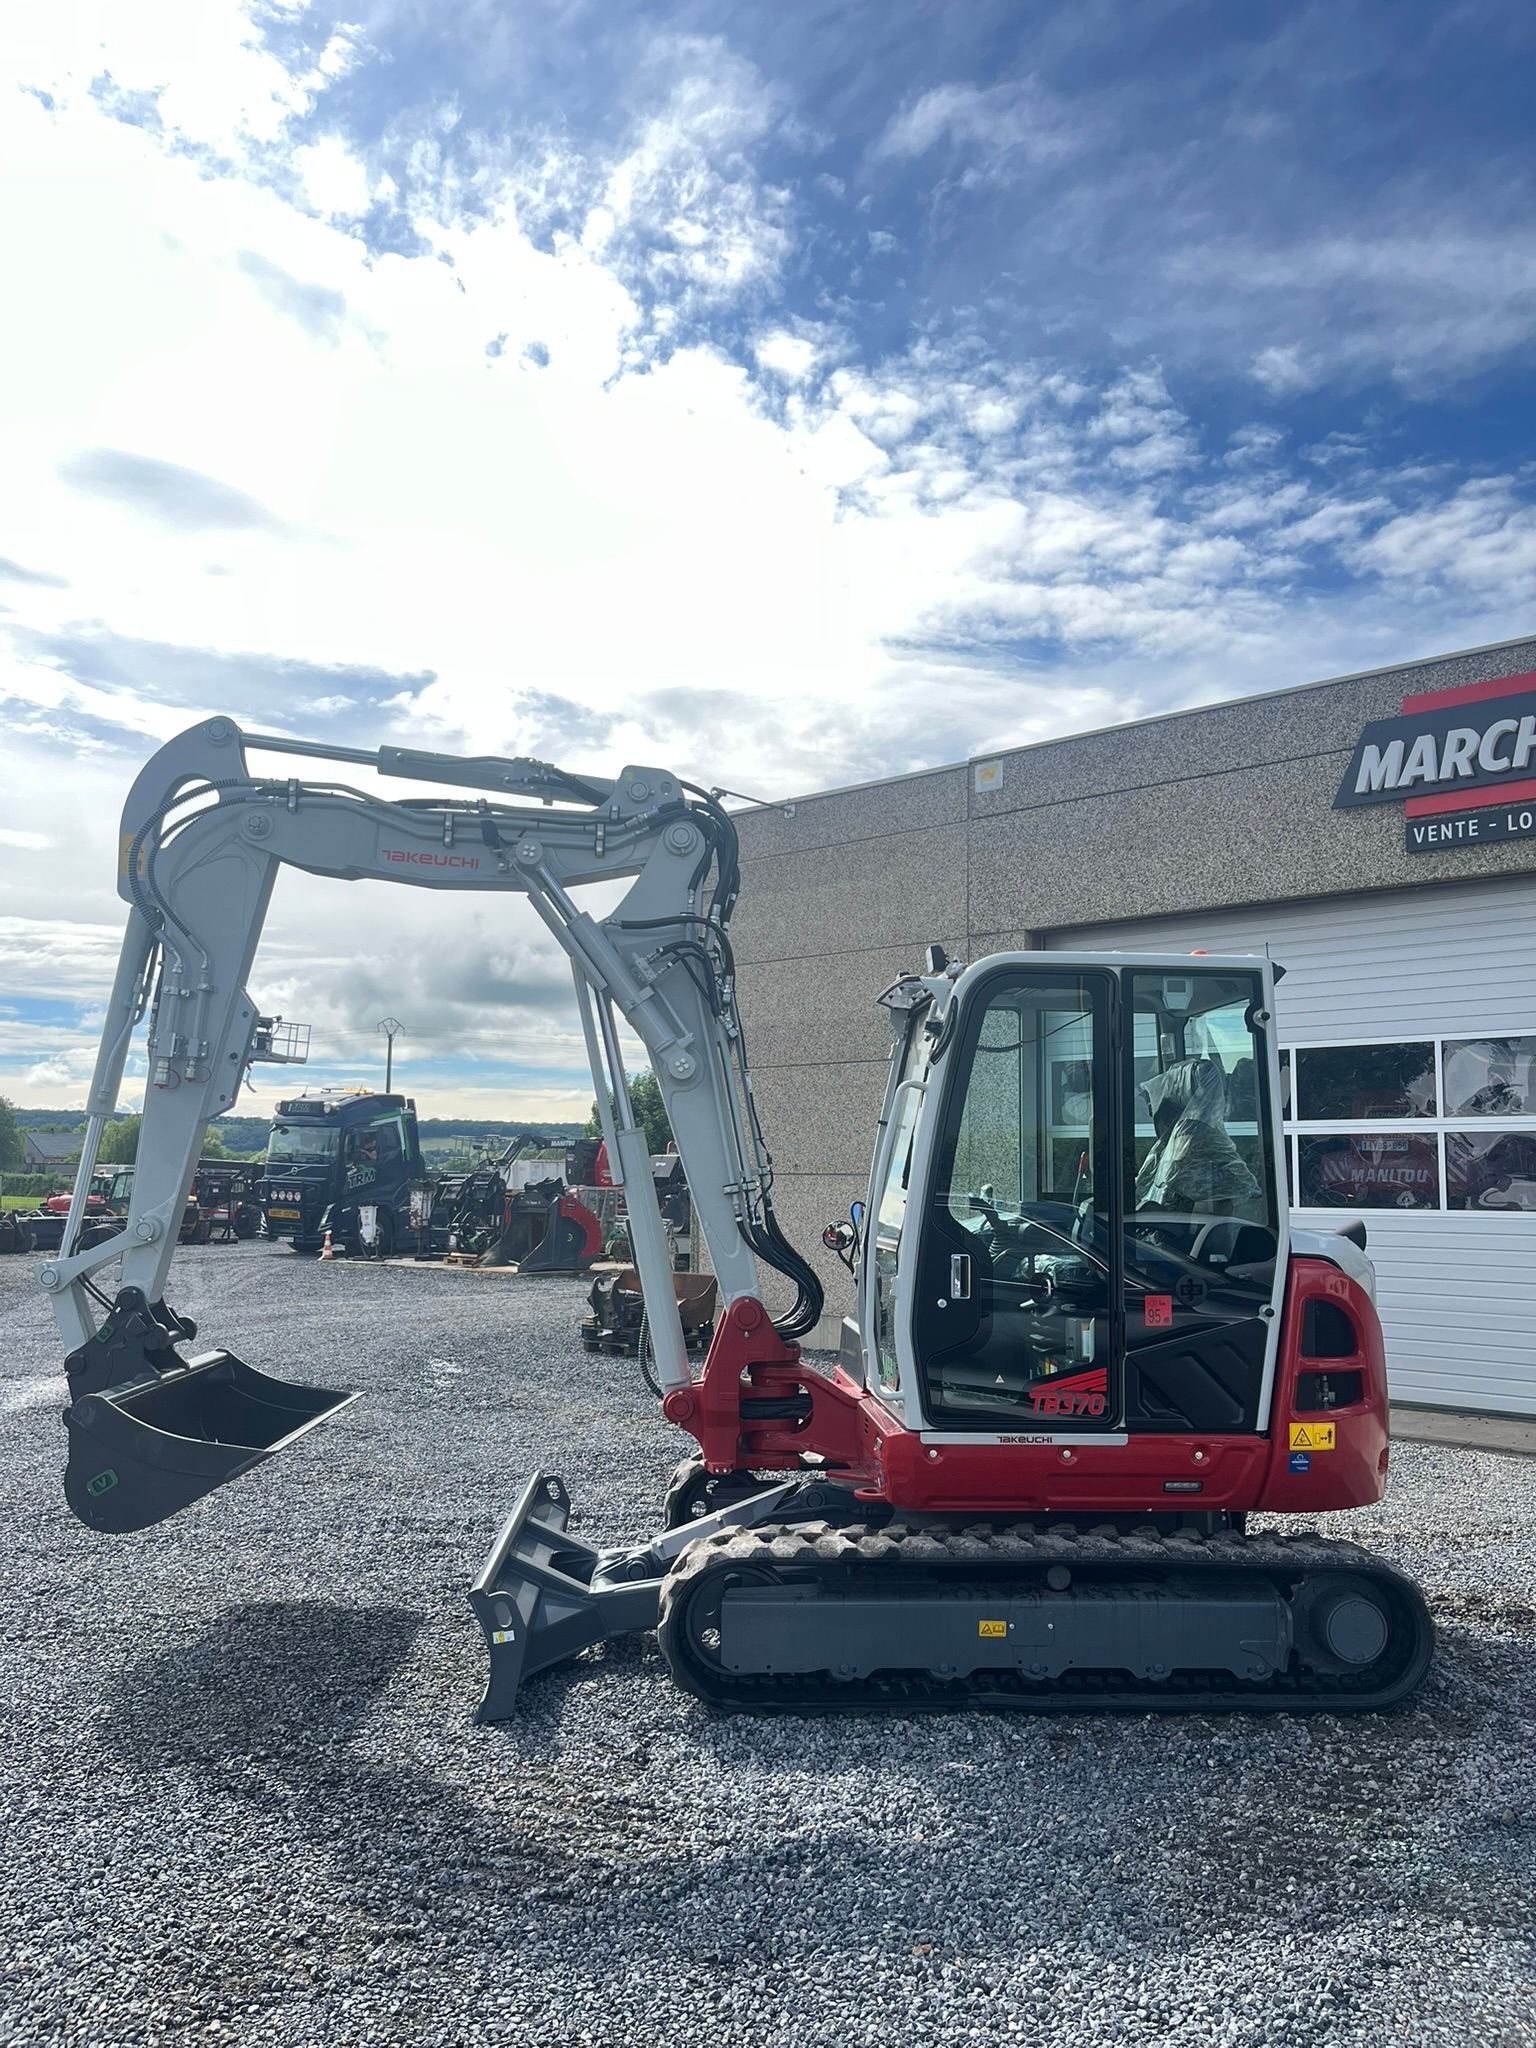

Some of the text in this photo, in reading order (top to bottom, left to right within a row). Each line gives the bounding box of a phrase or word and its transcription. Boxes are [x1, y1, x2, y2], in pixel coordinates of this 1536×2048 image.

[1413, 819, 1479, 844] VENTE
[1507, 812, 1533, 832] LO
[1351, 1168, 1429, 1182] MANITOU
[1148, 1308, 1161, 1323] 95
[1029, 1391, 1106, 1416] TB370
